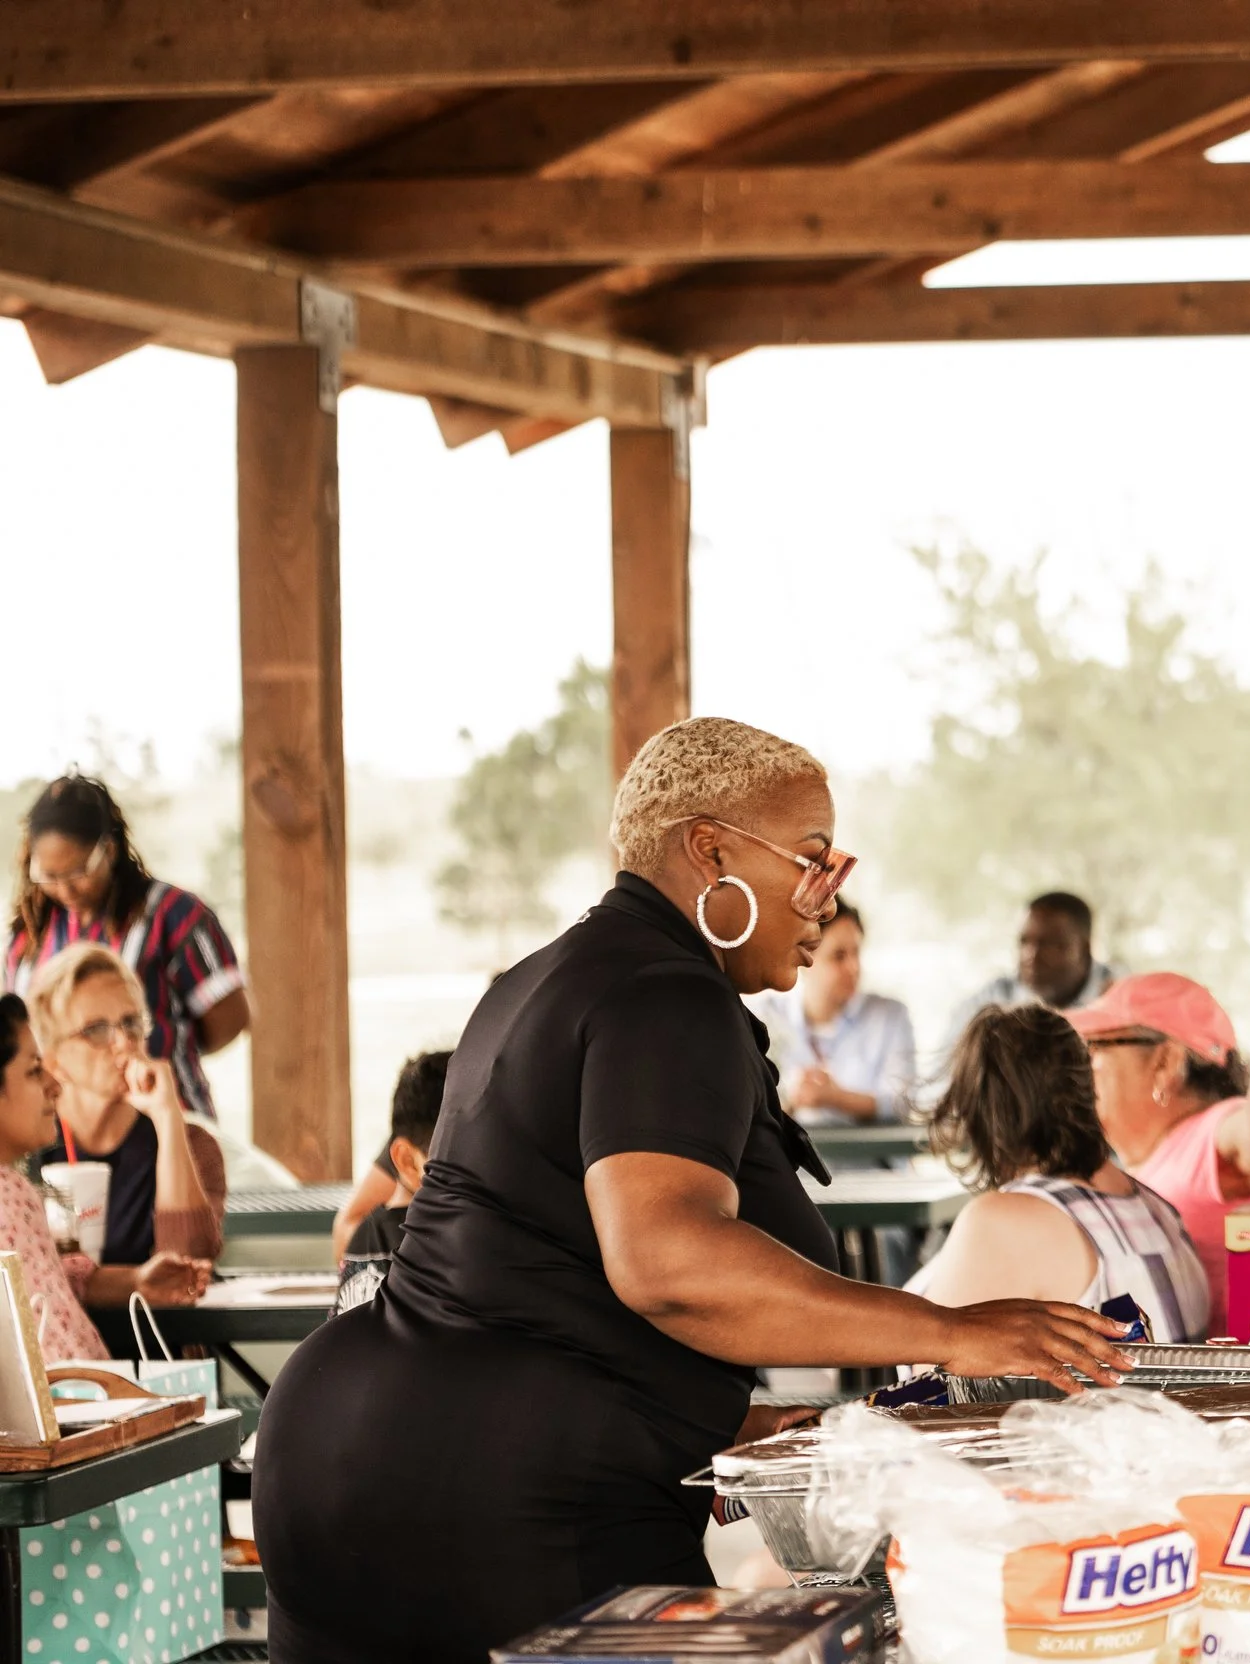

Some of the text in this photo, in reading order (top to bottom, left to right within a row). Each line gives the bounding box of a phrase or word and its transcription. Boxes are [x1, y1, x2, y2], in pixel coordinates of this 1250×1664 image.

[1078, 1545, 1193, 1600] Hefty
[1037, 1628, 1145, 1653] SOAK PROOF
[1202, 1634, 1218, 1656] 0
